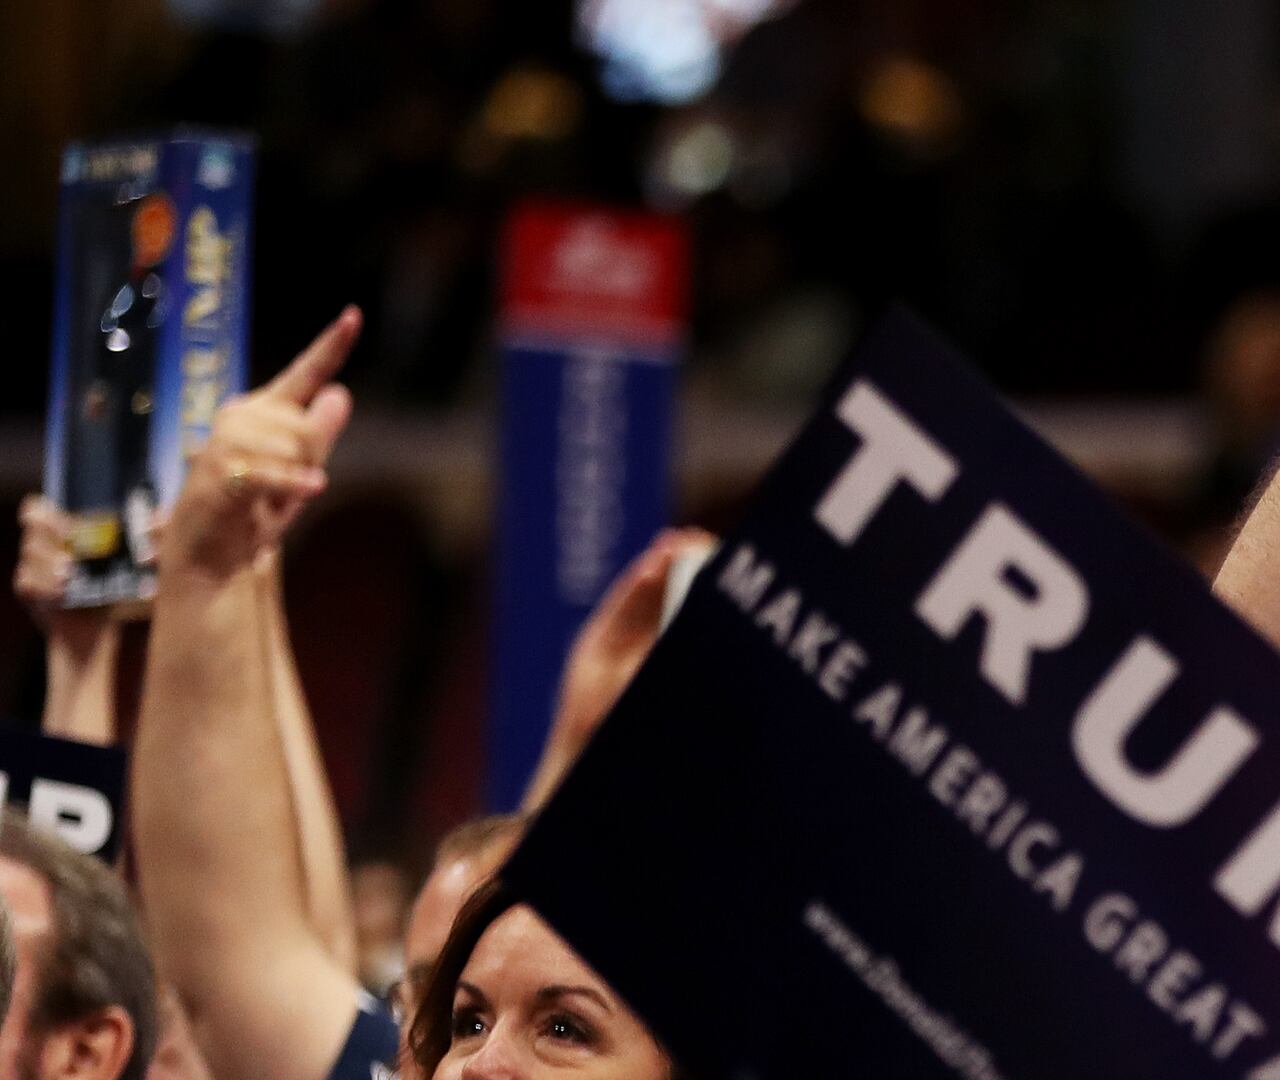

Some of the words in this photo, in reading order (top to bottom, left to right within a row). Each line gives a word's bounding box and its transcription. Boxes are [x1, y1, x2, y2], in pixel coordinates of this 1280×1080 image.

[716, 543, 869, 701] MAKE
[854, 684, 1086, 911] AMERICA
[1083, 891, 1266, 1060] GREAT
